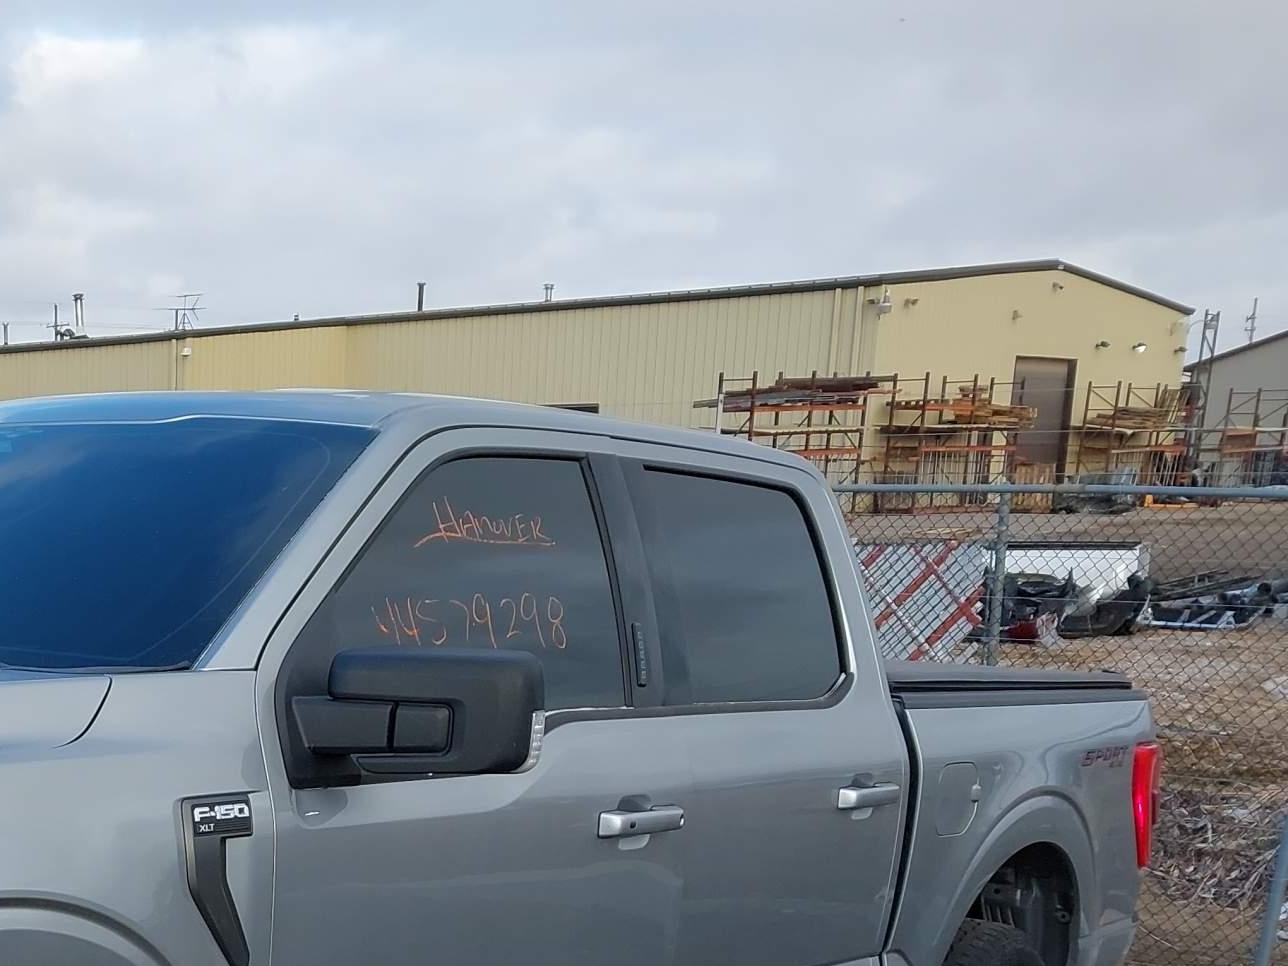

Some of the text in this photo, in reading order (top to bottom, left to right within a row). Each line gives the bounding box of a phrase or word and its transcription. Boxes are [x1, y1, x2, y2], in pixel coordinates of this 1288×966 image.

[371, 592, 567, 649] 44579298
[193, 803, 250, 823] F-150
[199, 823, 215, 833] XLT
